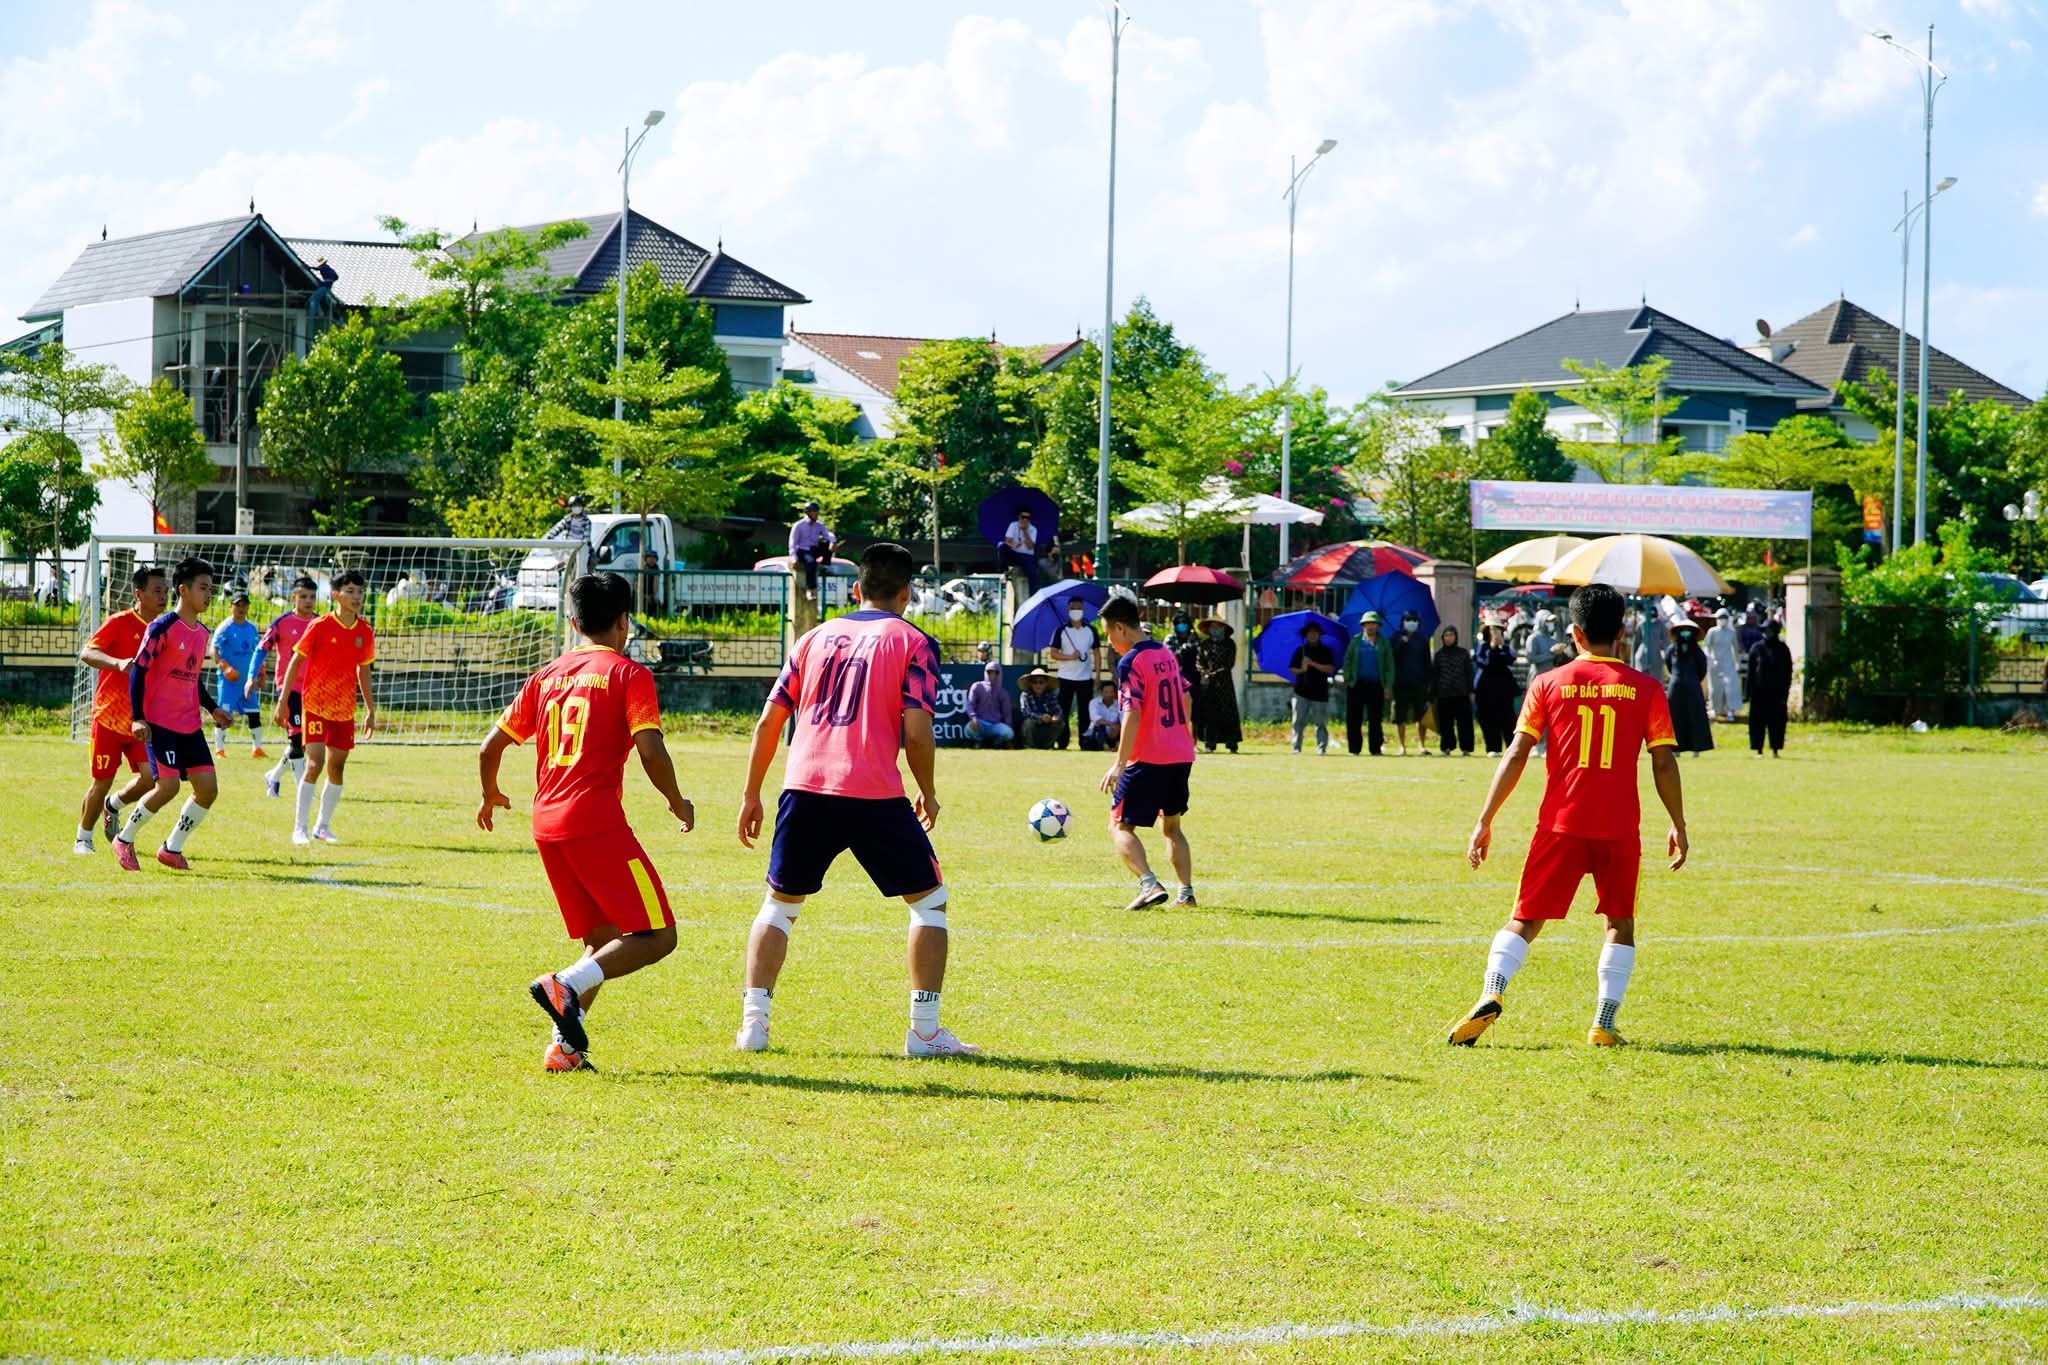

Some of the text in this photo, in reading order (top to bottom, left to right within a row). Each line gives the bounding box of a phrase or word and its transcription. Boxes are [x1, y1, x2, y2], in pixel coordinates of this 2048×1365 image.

[823, 635, 881, 649] FC 17
[1153, 662, 1166, 675] FC
[811, 655, 868, 727] 10
[1560, 685, 1577, 699] TDP
[1580, 680, 1599, 698] BẮC
[1158, 676, 1186, 728] 91
[308, 720, 323, 735] 83
[545, 695, 590, 769] 19
[1577, 704, 1616, 770] 11
[165, 750, 176, 765] 17
